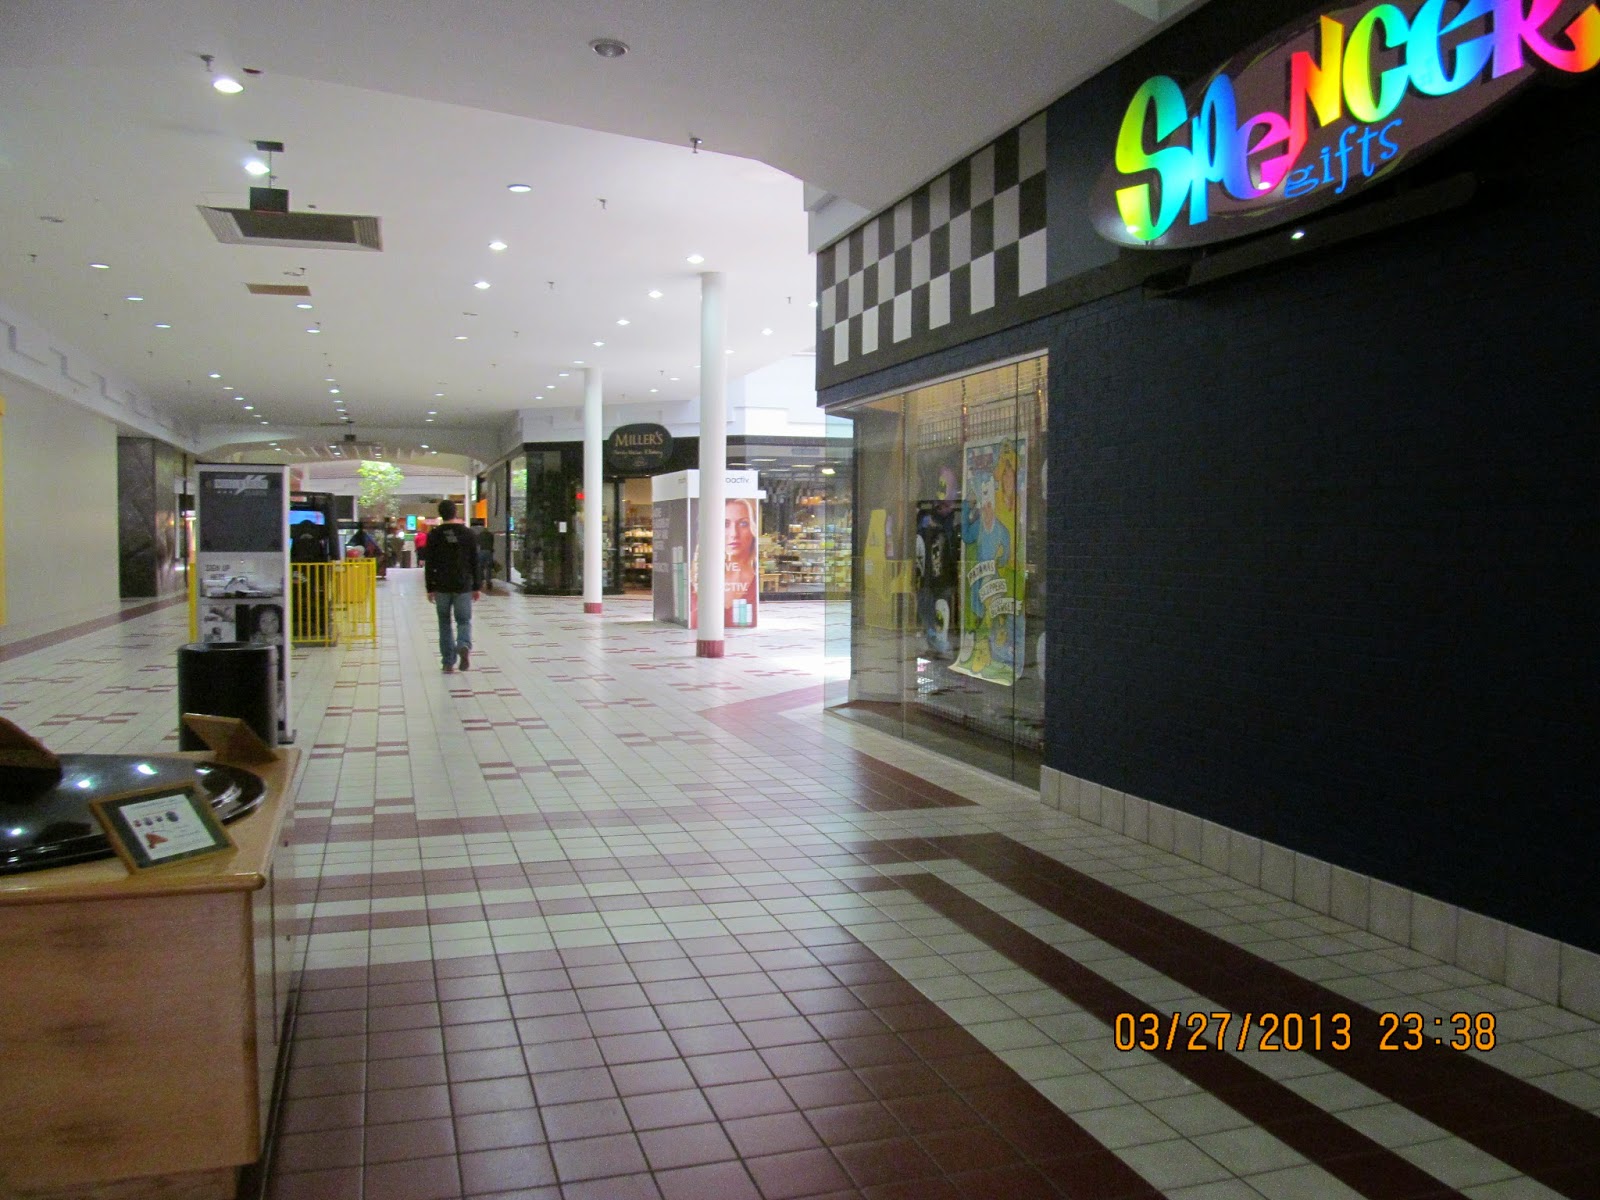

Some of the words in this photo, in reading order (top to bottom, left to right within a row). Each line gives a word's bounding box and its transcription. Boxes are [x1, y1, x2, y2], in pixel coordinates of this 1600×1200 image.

[1283, 118, 1403, 199] gifts
[615, 431, 663, 447] MILLER'S
[725, 476, 750, 484] oactiv
